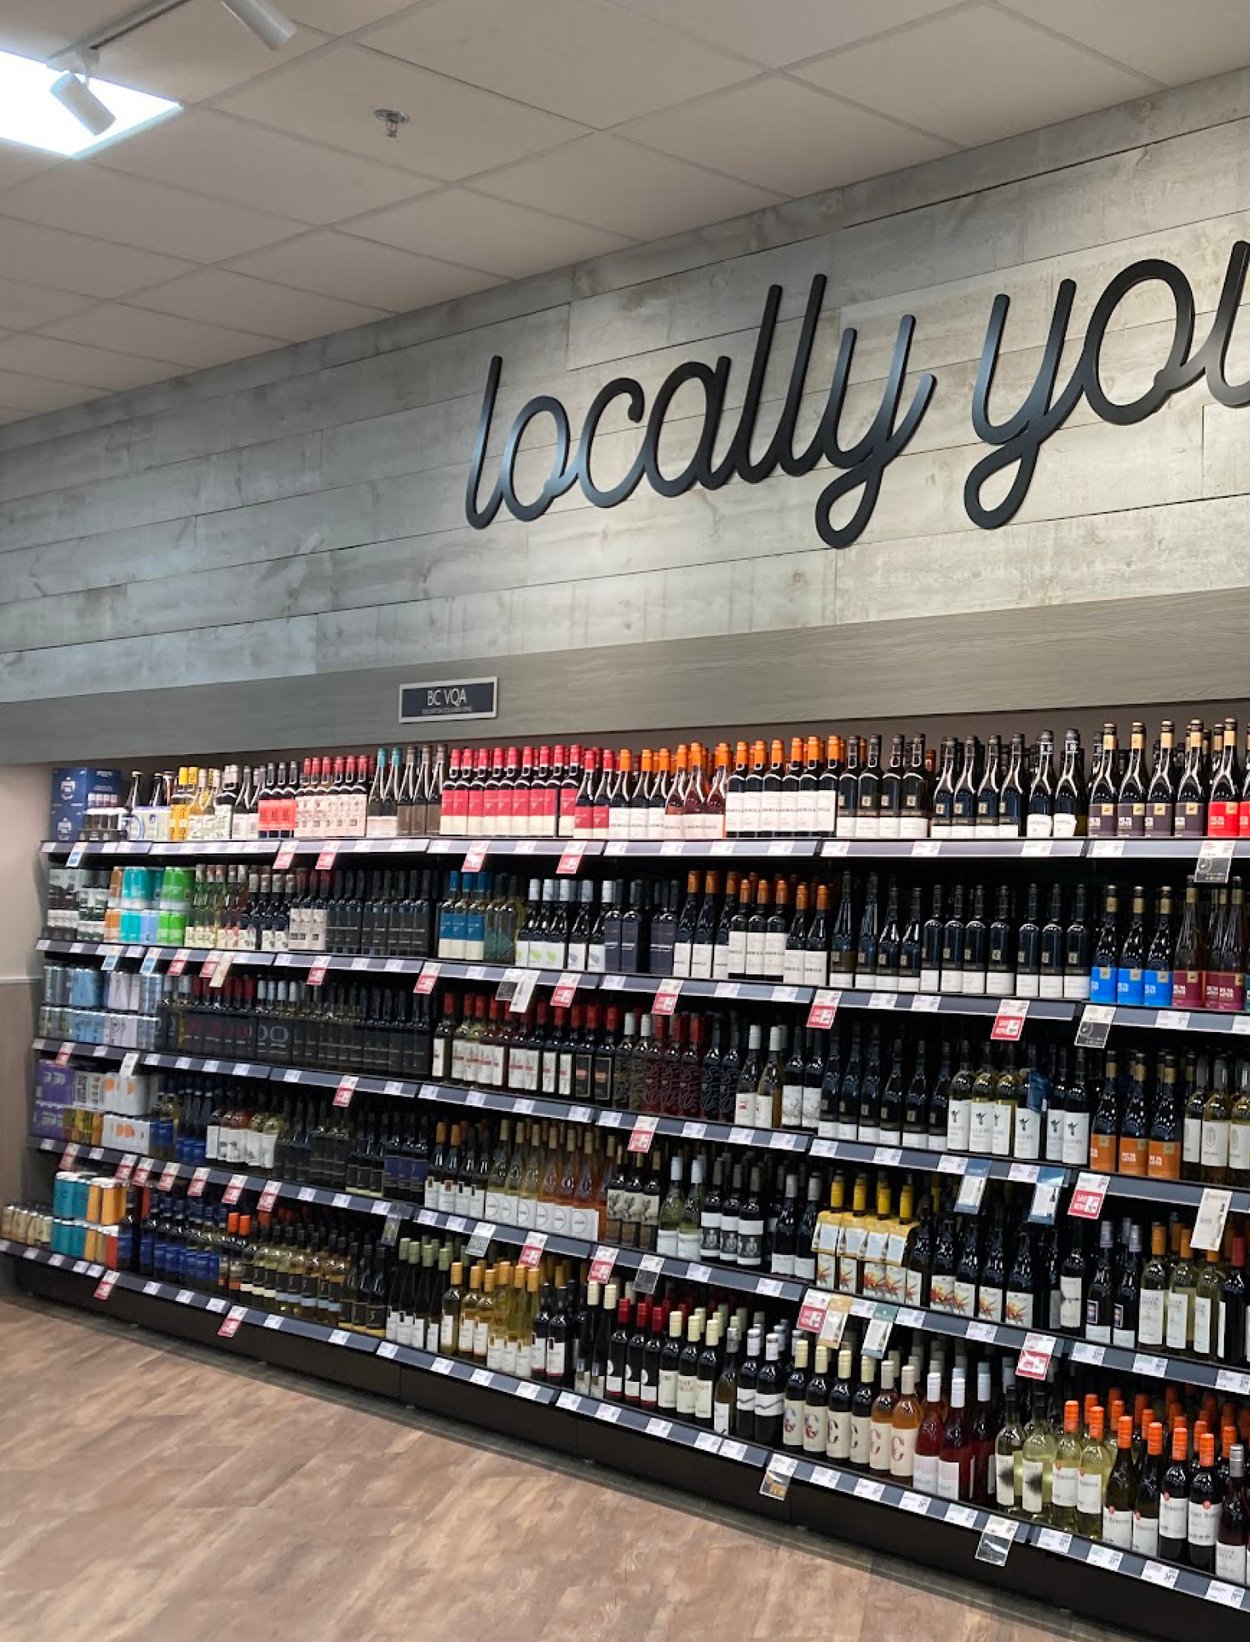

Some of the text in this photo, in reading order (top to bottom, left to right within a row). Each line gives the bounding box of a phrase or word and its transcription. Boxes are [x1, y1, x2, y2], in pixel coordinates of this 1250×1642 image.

[465, 273, 936, 548] locally
[427, 688, 467, 707] BC VQA
